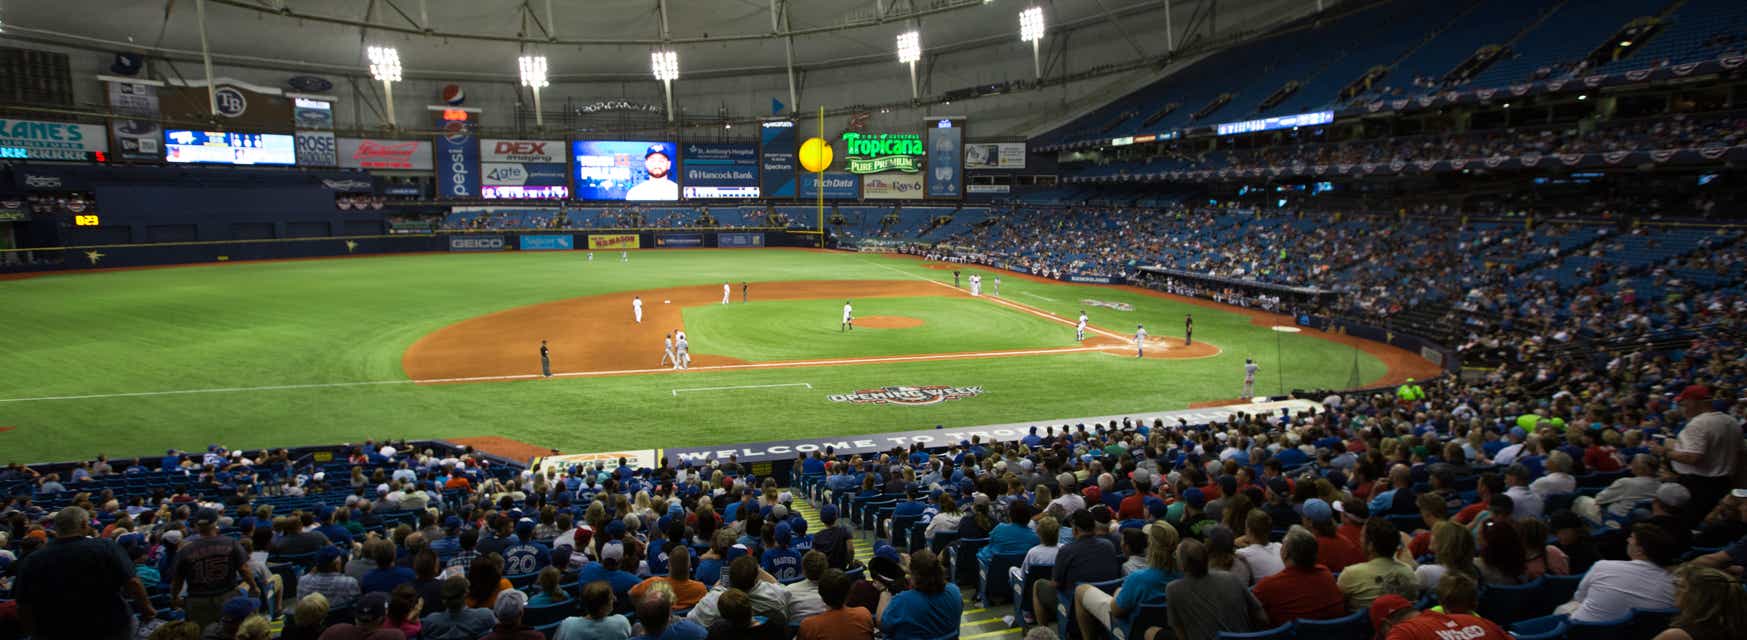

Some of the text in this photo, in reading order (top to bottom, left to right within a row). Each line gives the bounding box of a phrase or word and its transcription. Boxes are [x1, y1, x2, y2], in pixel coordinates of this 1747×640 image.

[298, 135, 334, 152] ROSE
[494, 142, 547, 155] DEX
[842, 131, 923, 157] Tropicana
[851, 157, 913, 171] PURE PREMIUM
[449, 148, 469, 195] pepsi
[500, 167, 522, 178] gte
[699, 171, 753, 179] Hancock Bank
[452, 238, 503, 249] GEICO
[828, 390, 927, 402] OPENING
[676, 434, 935, 461] WELCOME TO
[508, 554, 536, 573] 20
